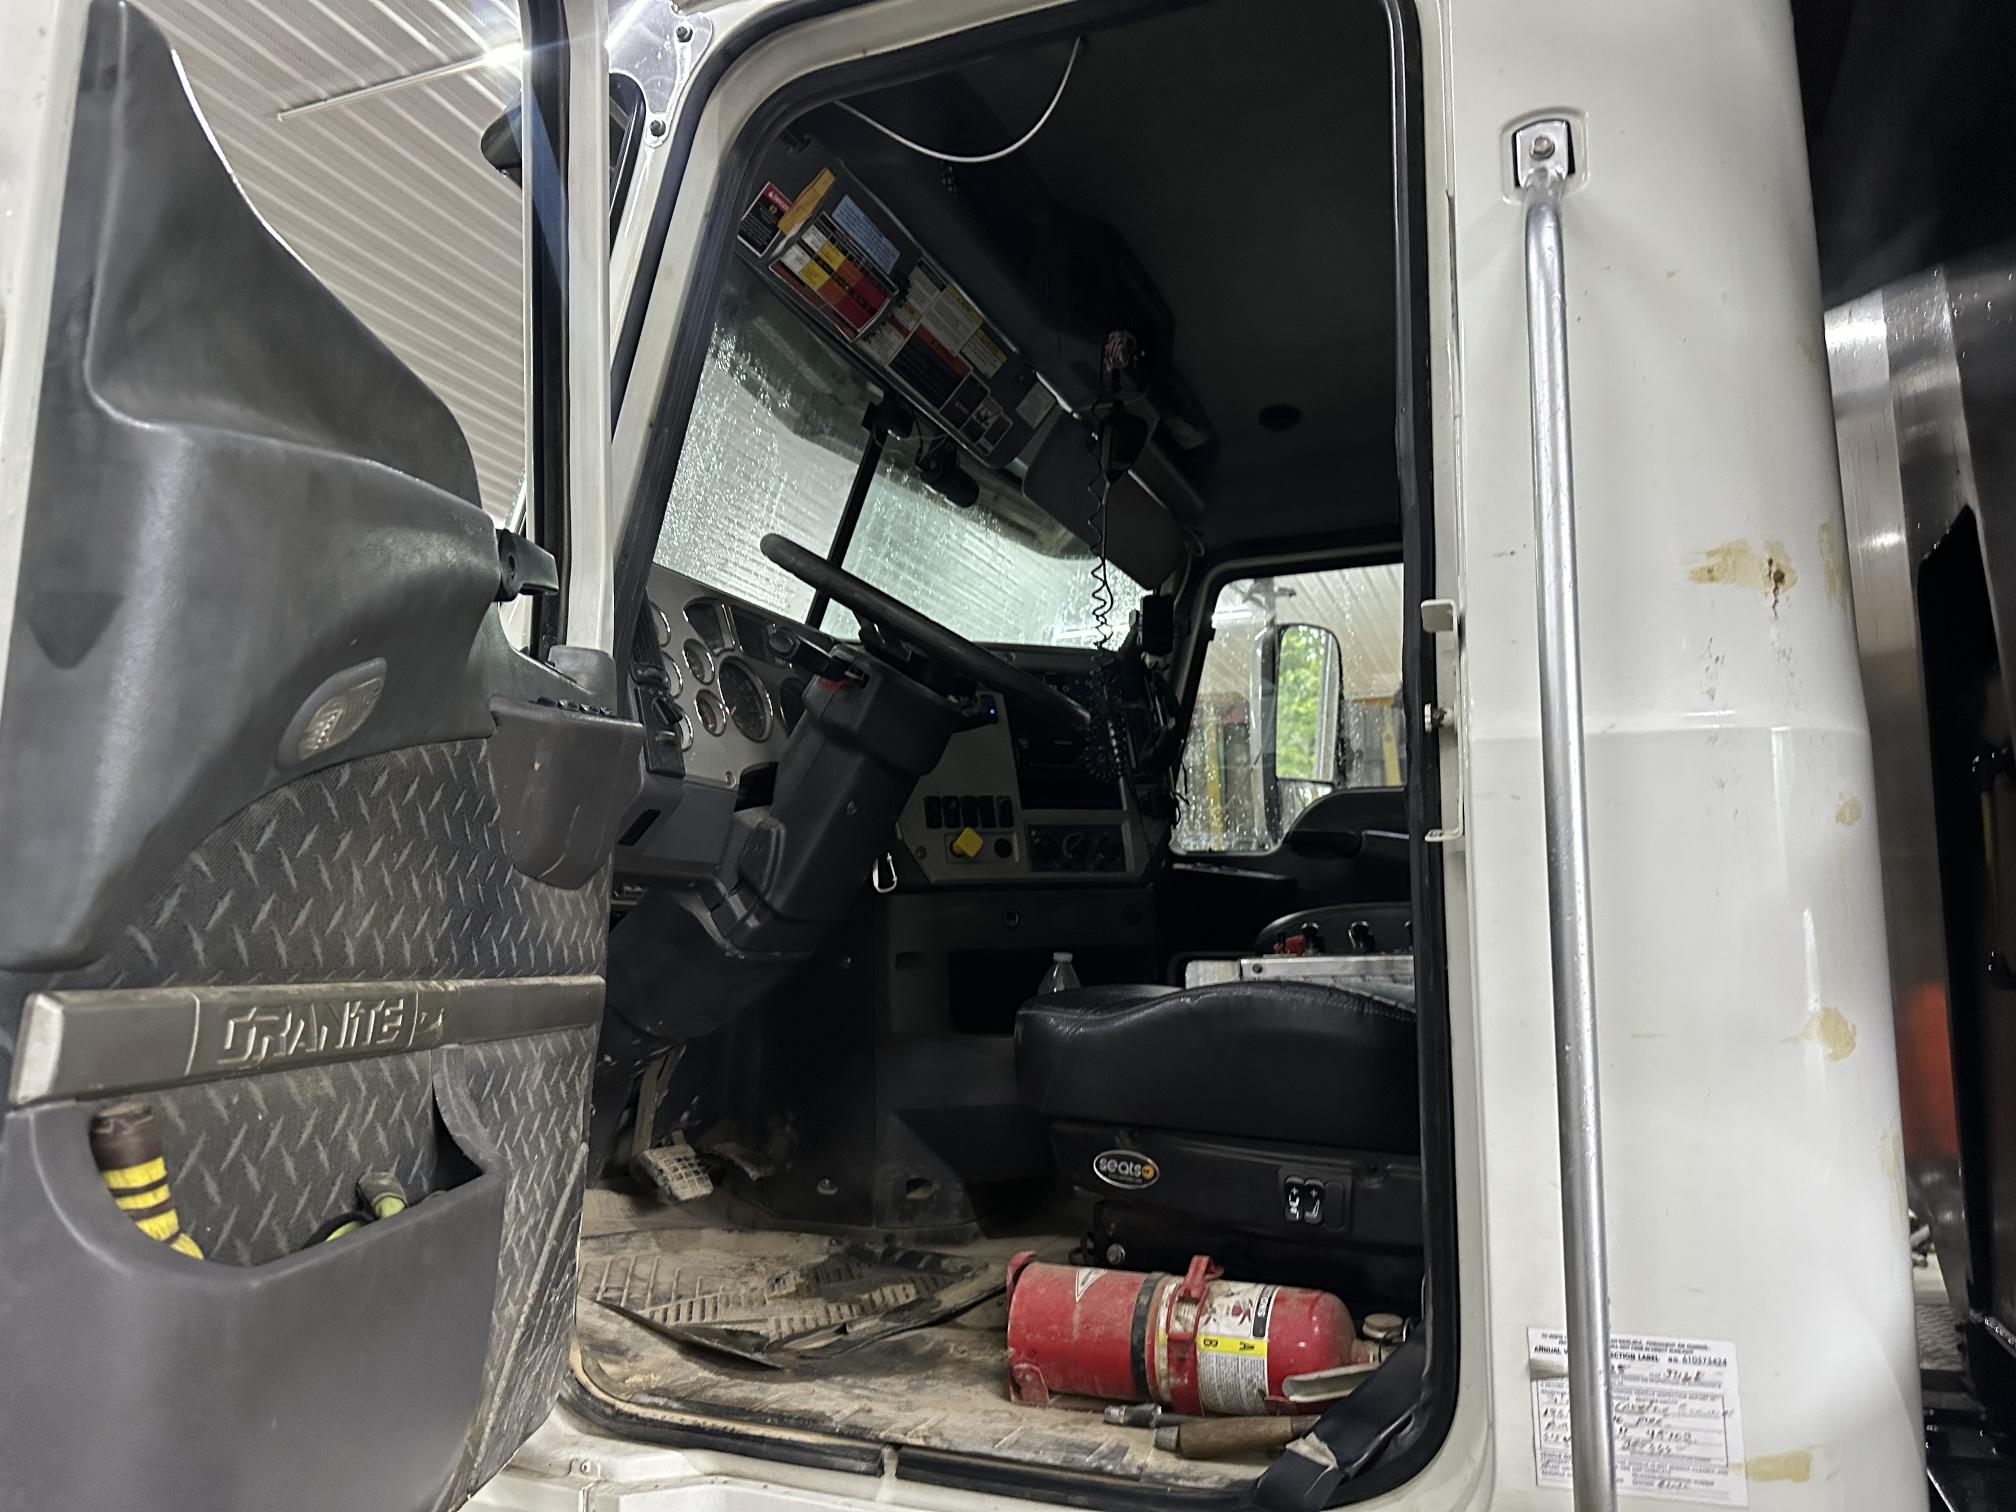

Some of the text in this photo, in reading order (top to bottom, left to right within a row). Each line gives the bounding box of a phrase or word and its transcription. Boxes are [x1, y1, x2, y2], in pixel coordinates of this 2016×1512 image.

[217, 998, 404, 1065] GRANITE
[1099, 1157, 1142, 1178] seats
[1203, 1338, 1218, 1348] B
[1238, 1341, 1255, 1352] A
[1637, 1354, 1660, 1363] LABEL
